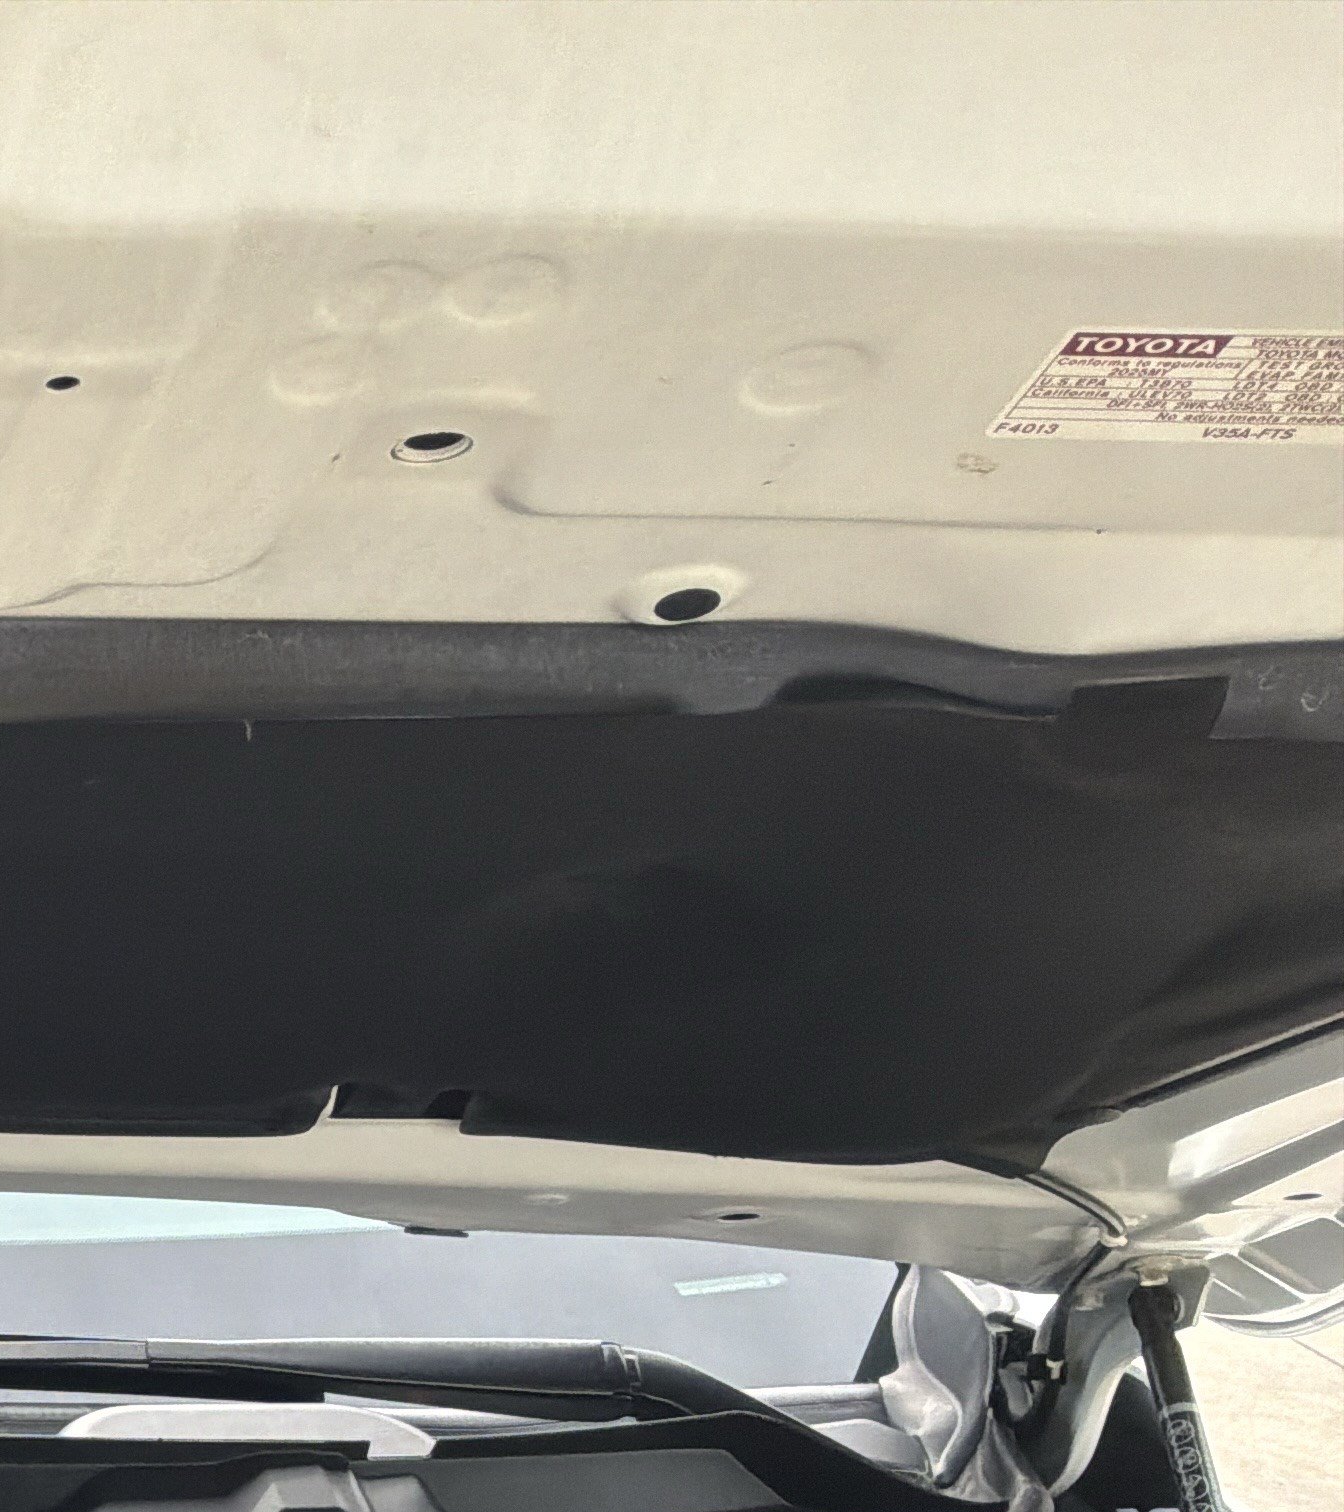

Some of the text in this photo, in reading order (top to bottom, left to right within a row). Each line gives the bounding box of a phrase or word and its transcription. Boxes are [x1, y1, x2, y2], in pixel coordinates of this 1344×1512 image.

[1074, 336, 1217, 355] TOYOTA
[1256, 349, 1319, 360] TOYOTA
[1057, 357, 1243, 371] Conforms to regulations
[1257, 361, 1303, 370] TEST
[1030, 388, 1111, 398] California
[1153, 412, 1178, 422] No
[1183, 413, 1281, 424] adjustments
[993, 422, 1297, 439] F4013 V35A-FTS
